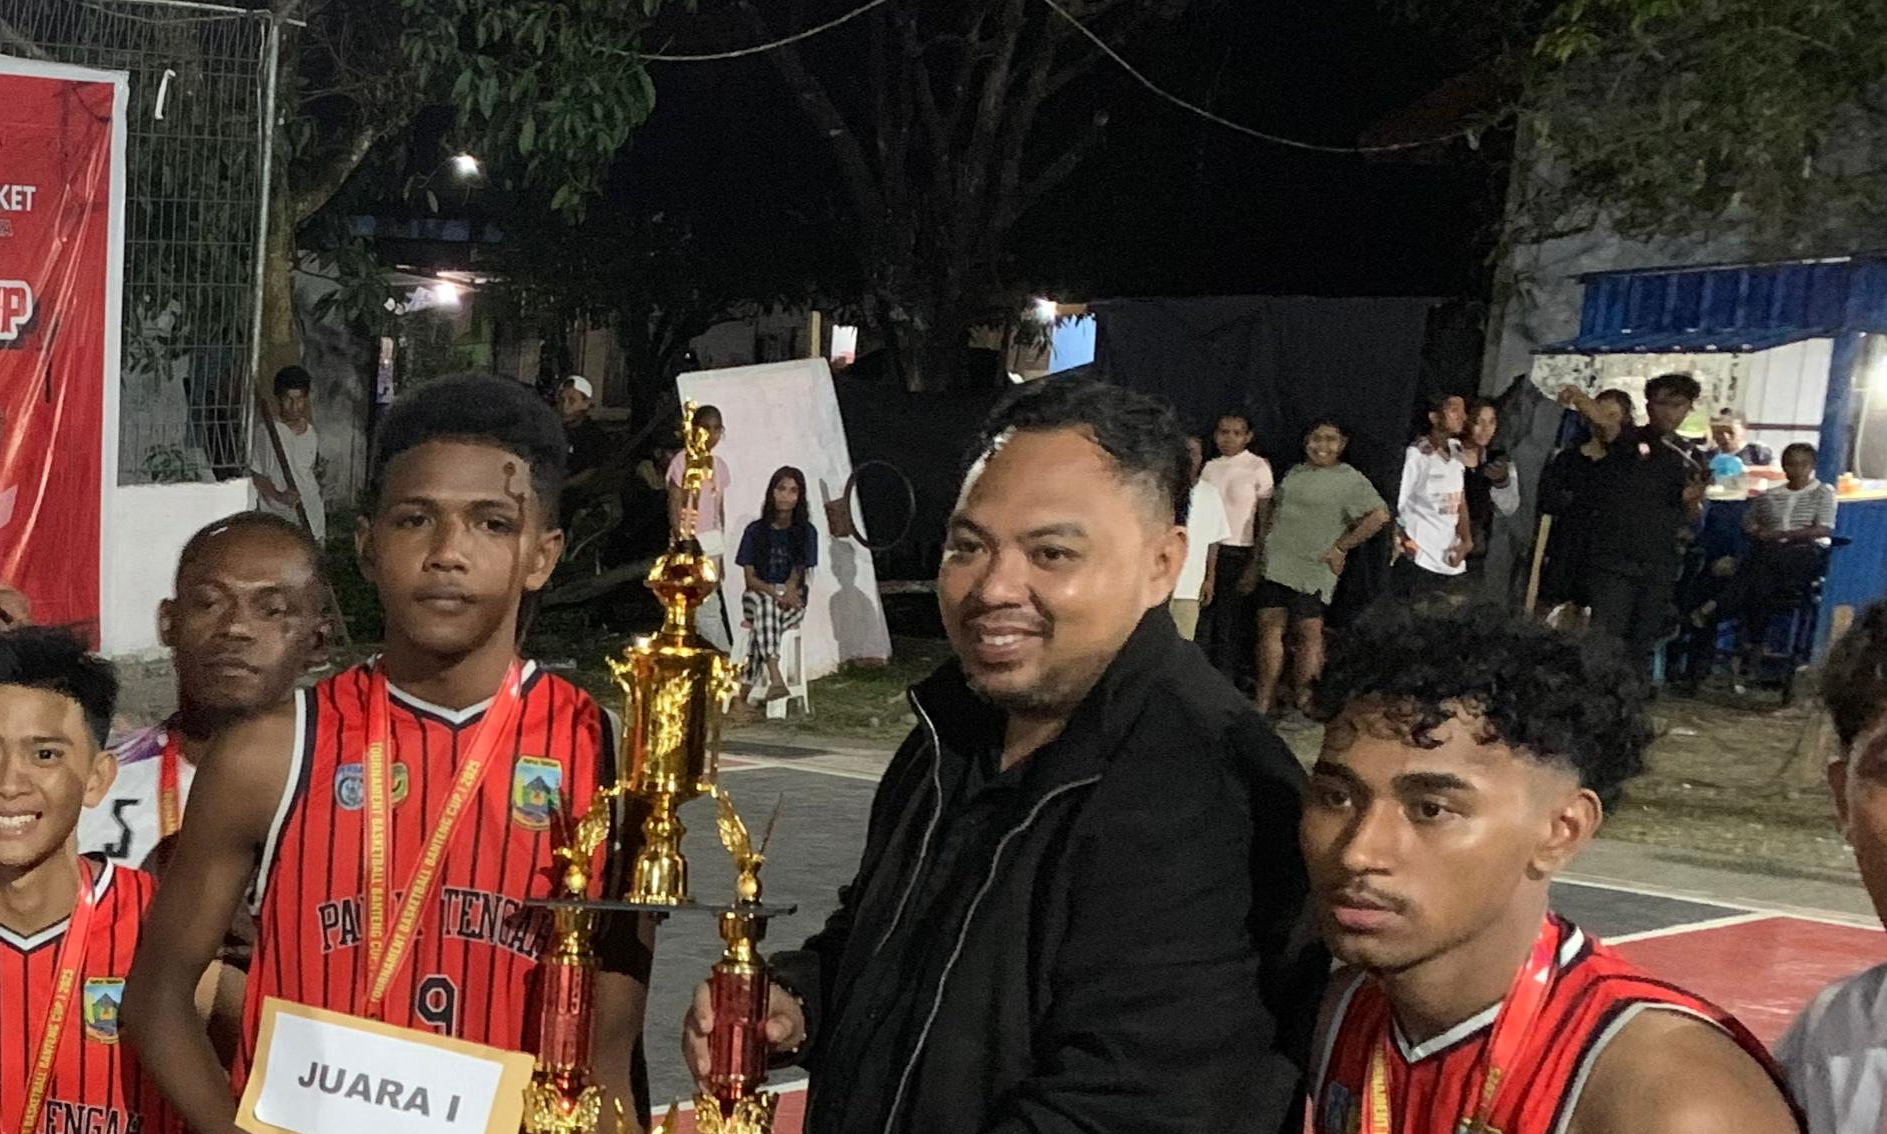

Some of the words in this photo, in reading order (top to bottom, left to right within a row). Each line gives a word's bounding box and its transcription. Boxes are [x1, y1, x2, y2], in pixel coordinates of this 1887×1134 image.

[367, 932, 405, 1004] TOURNAMENT
[398, 867, 433, 933] BASKETBALL
[423, 816, 452, 867] BANTENG
[445, 792, 464, 817] CUP
[457, 757, 483, 787] 2025
[370, 817, 384, 882] BASKETBALL
[415, 974, 458, 1037] 9
[298, 1062, 430, 1117] JUARA
